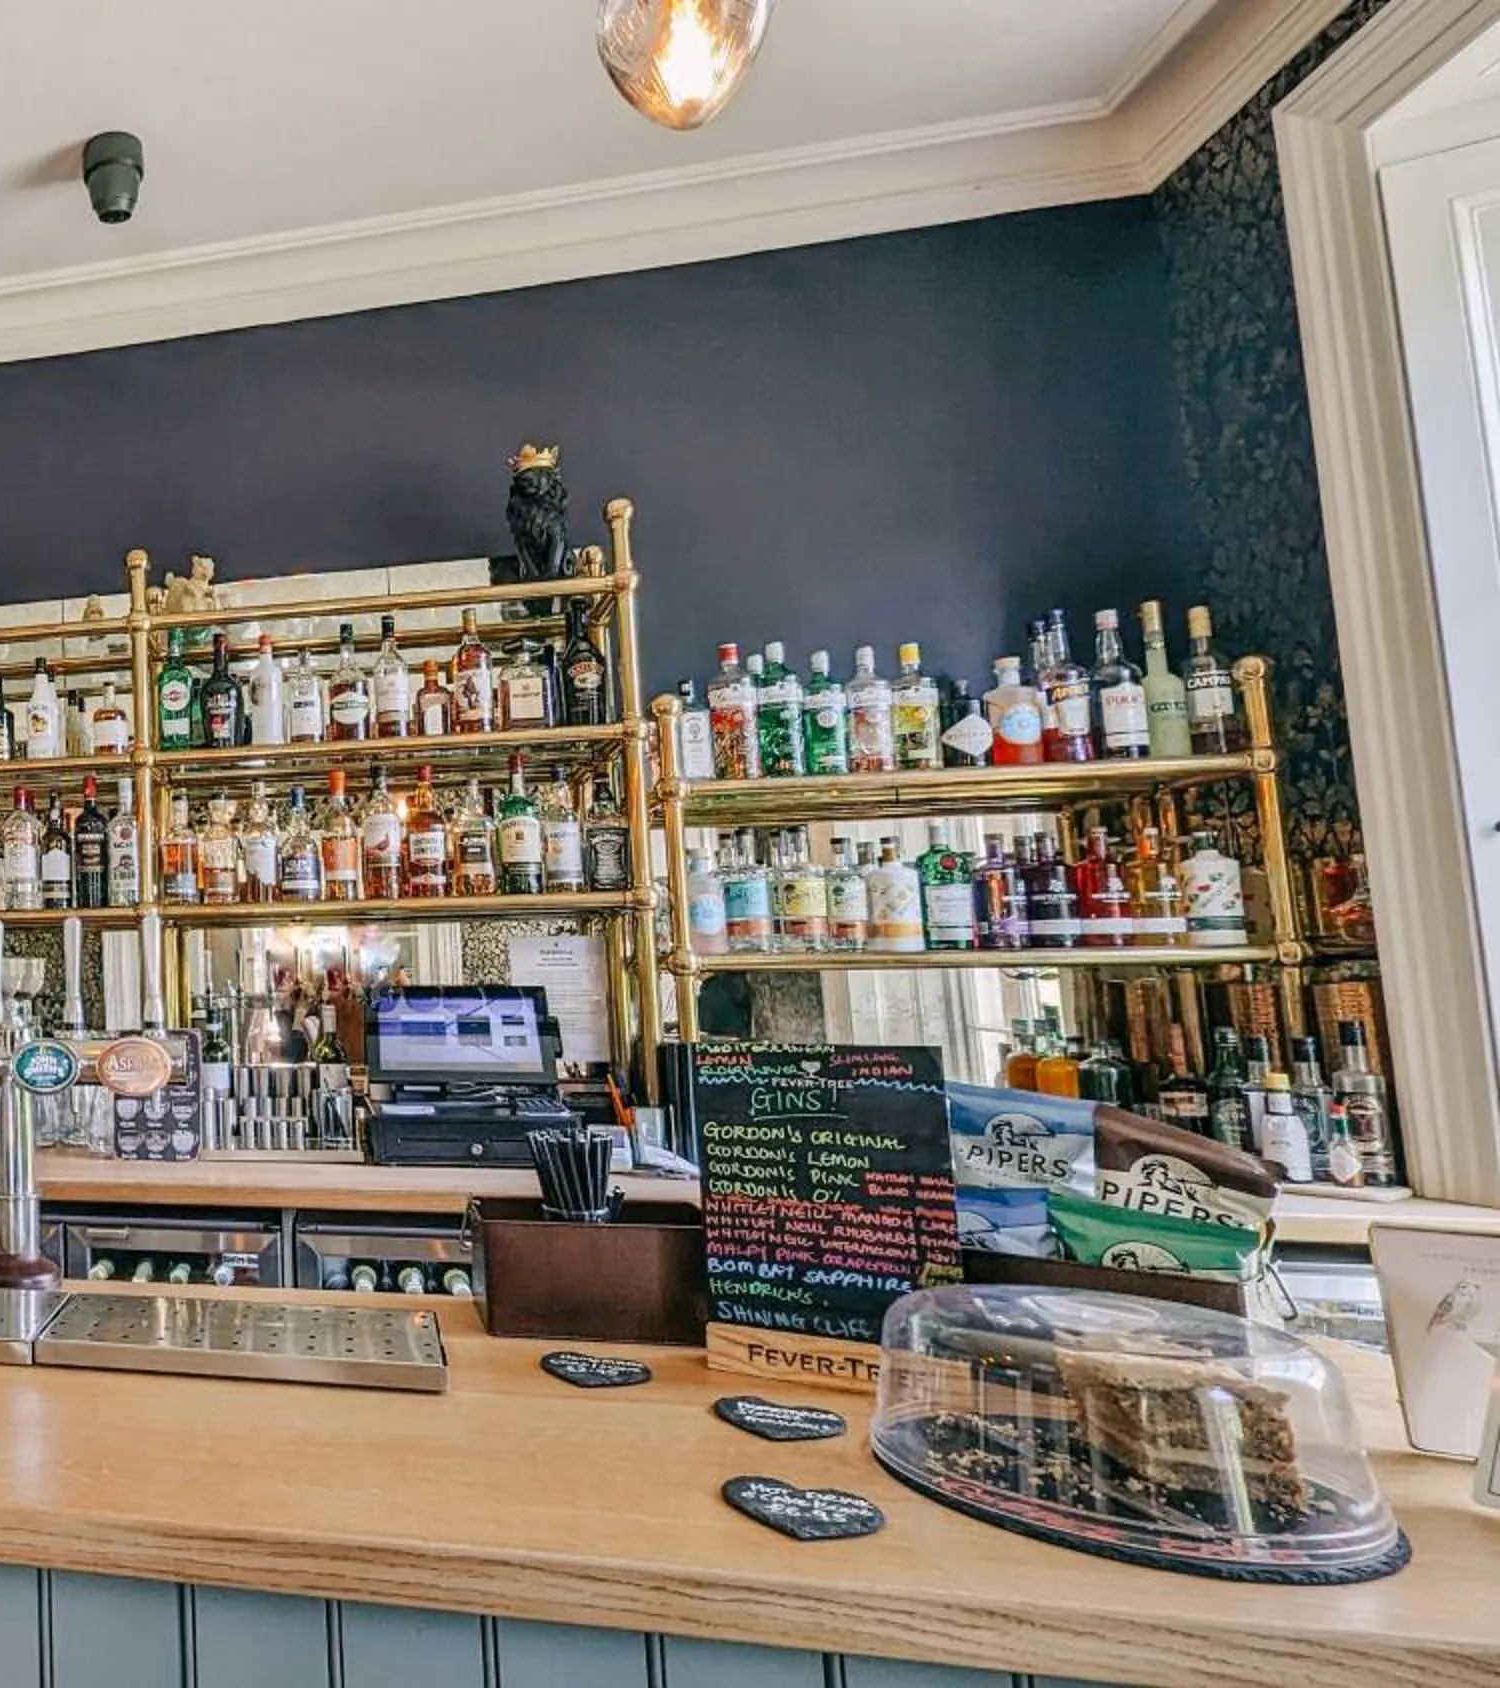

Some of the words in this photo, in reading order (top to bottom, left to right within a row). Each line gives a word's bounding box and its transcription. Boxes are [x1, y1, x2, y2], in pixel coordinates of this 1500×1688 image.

[810, 1131, 906, 1150] ORIGINAL
[807, 1151, 870, 1168] LEMON
[966, 1145, 1070, 1178] PIPERS
[811, 1168, 860, 1187] PINK
[802, 1269, 913, 1294] SAPPHIRE
[717, 1300, 806, 1327] SHINING
